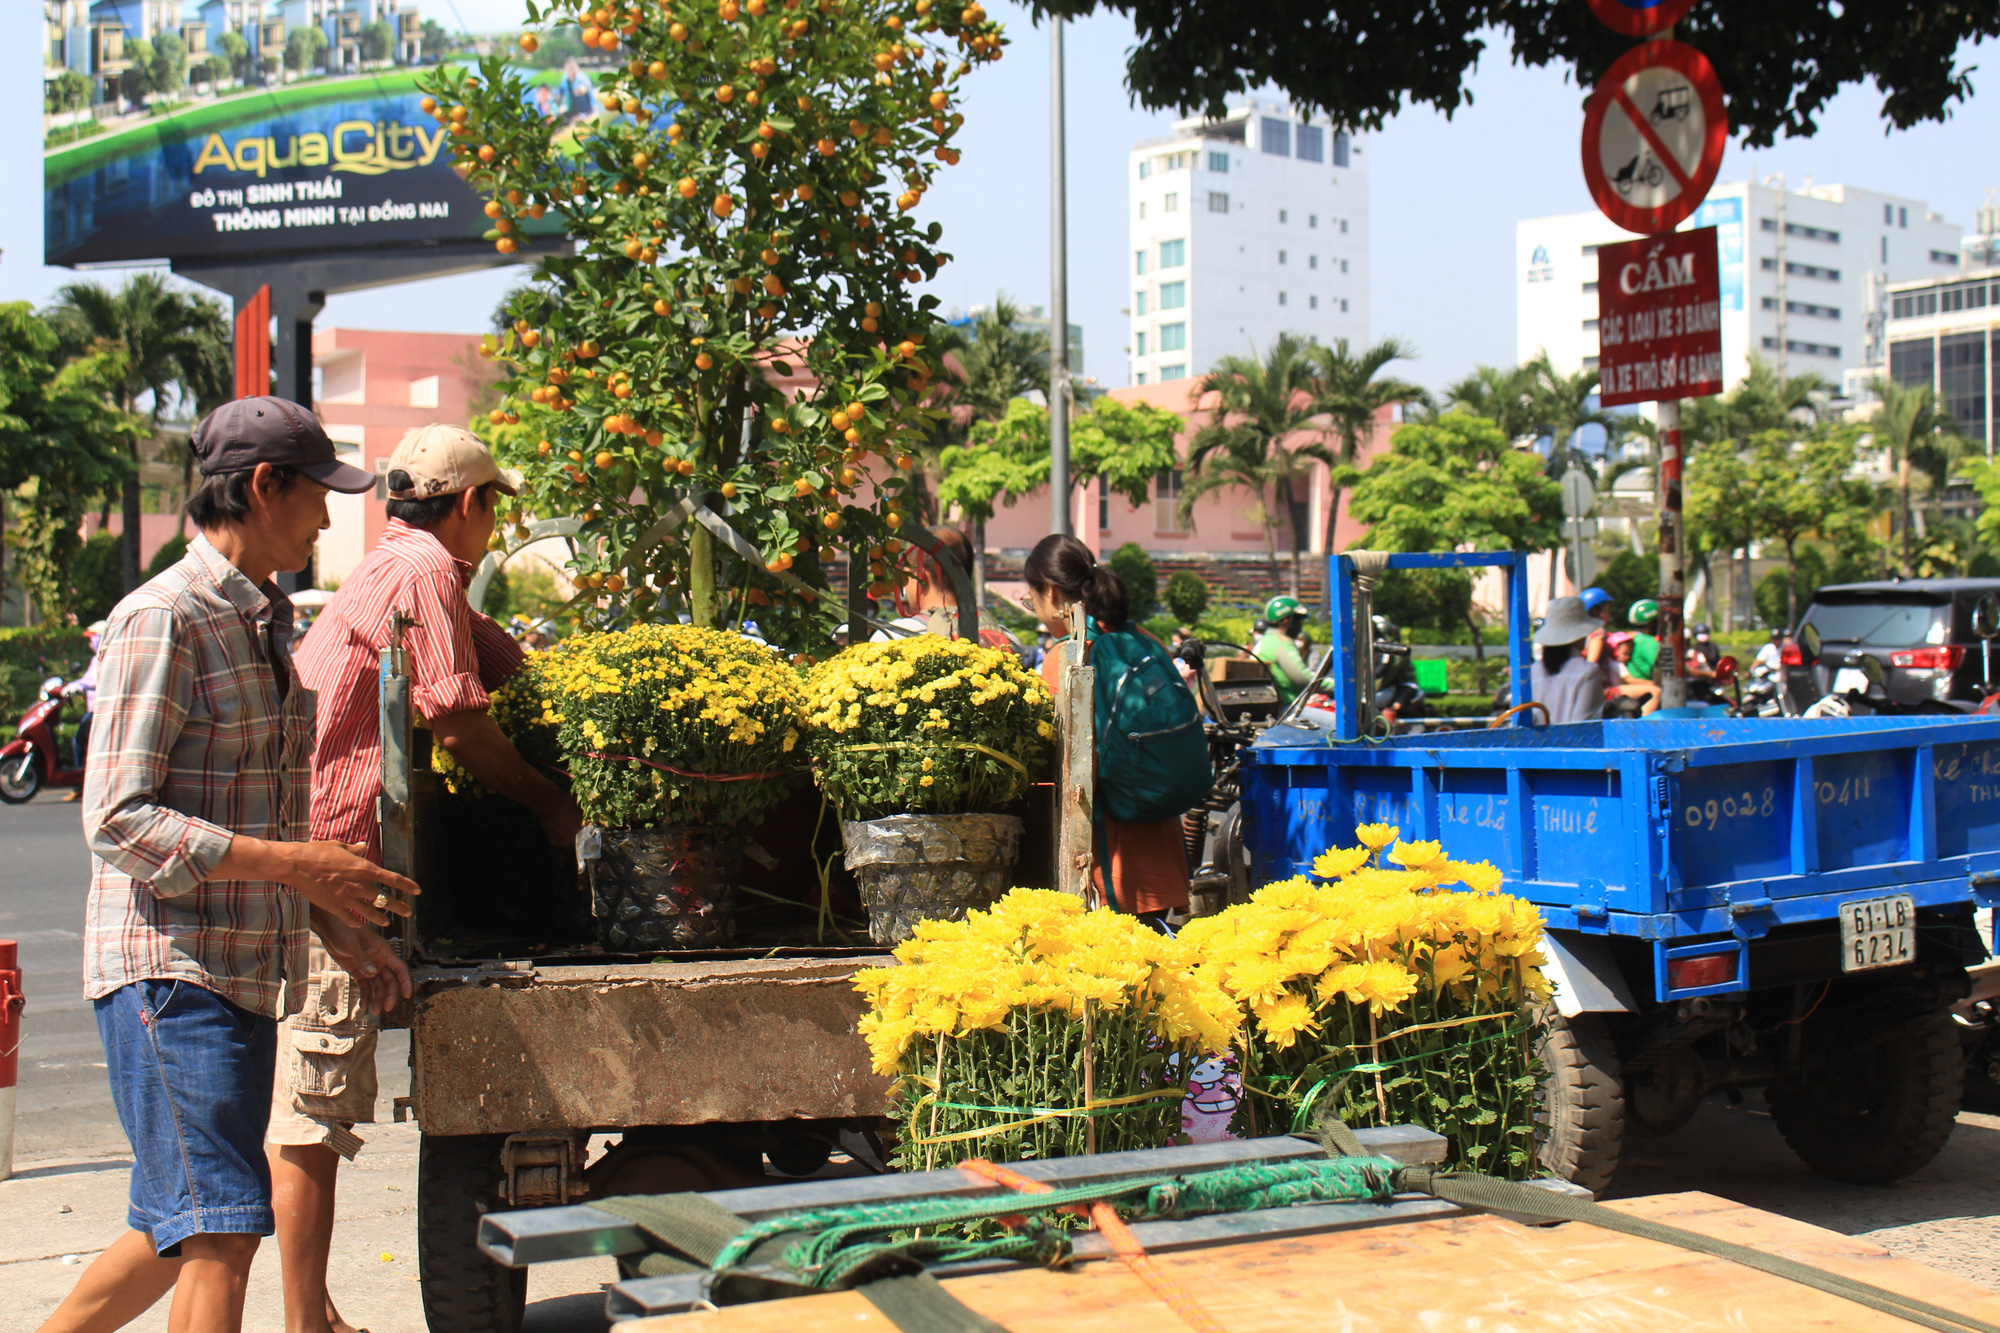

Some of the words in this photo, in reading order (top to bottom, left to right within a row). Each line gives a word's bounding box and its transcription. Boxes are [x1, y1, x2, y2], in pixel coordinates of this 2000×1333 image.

[247, 183, 293, 204] SINH
[295, 175, 342, 201] THÁI
[213, 208, 281, 231] THÔNG
[284, 206, 335, 227] MINH
[338, 206, 365, 225] TẠI
[419, 202, 449, 218] NAI
[1619, 243, 1696, 296] CẤM
[1601, 308, 1624, 347] CÁC
[1628, 310, 1656, 350] LOẠI
[1657, 307, 1674, 338] XE
[1675, 306, 1684, 337] 3
[1685, 295, 1719, 335] BÁNH
[1617, 364, 1633, 393] XE
[1678, 356, 1687, 386] 4
[1685, 787, 1775, 831] 09028
[1814, 777, 1869, 806] 0411
[1854, 931, 1907, 966] 6234
